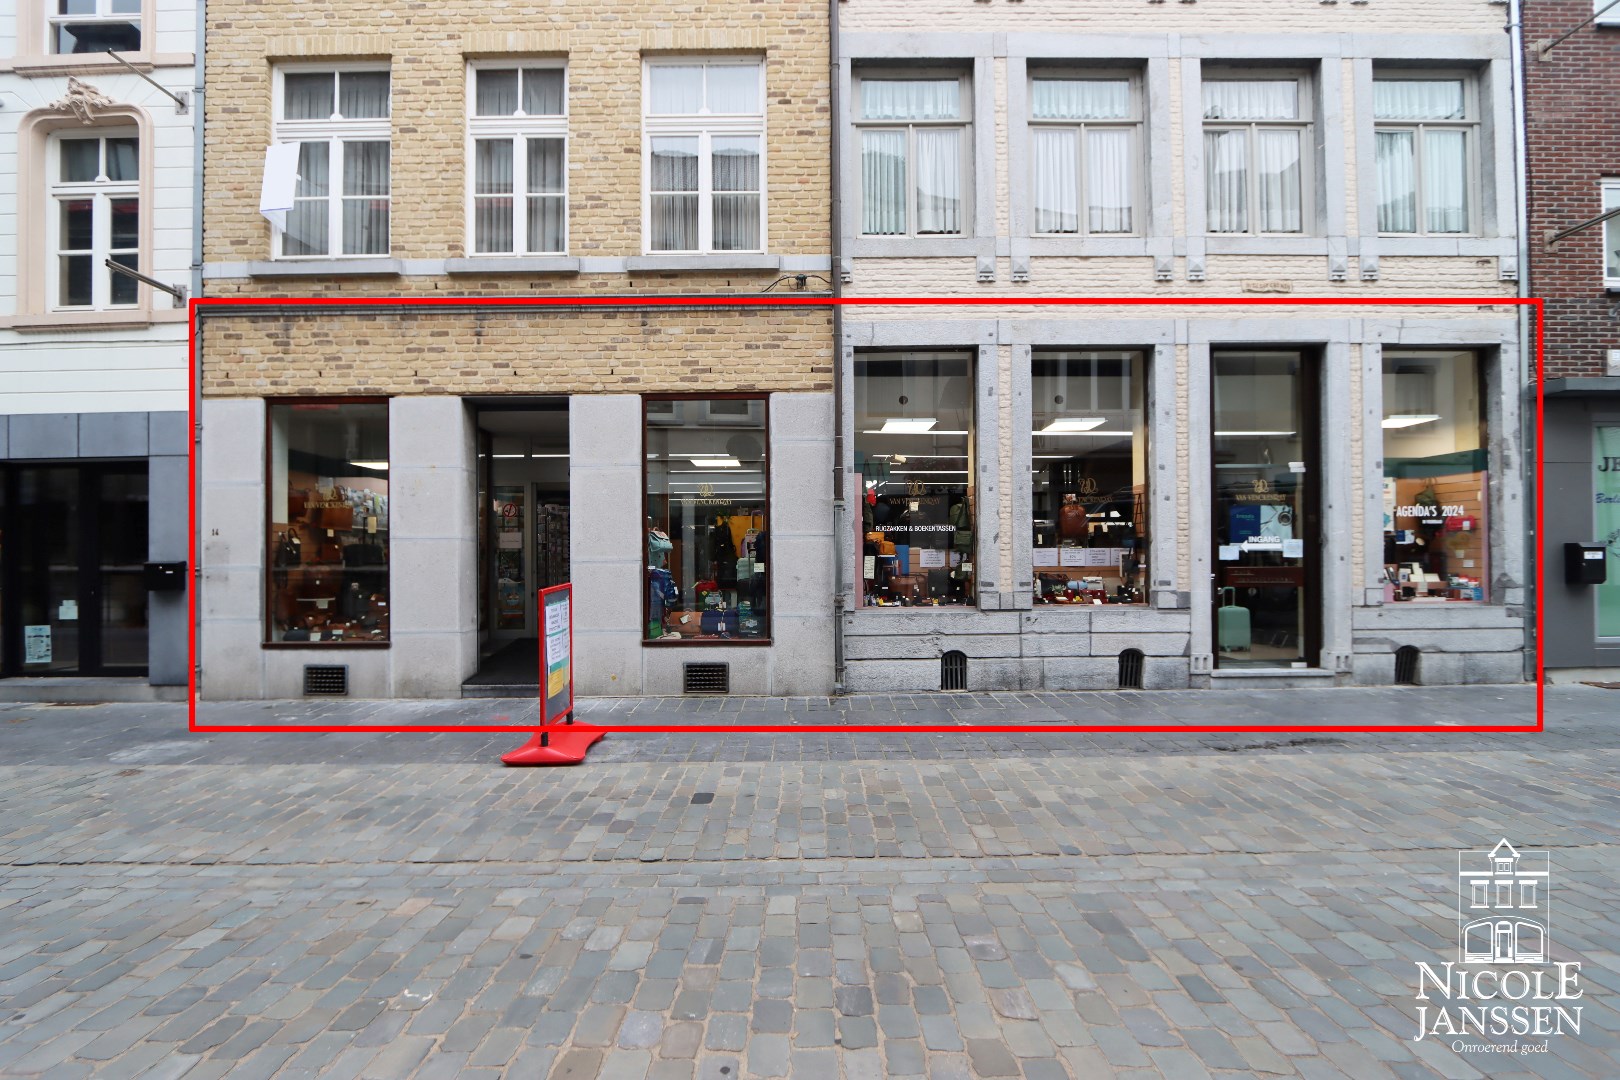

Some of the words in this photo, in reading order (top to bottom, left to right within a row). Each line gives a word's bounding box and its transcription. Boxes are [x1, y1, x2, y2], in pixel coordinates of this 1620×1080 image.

[1396, 505, 1437, 517] AGENDA'S
[1441, 505, 1464, 517] 2024
[1248, 535, 1280, 543] INGANG
